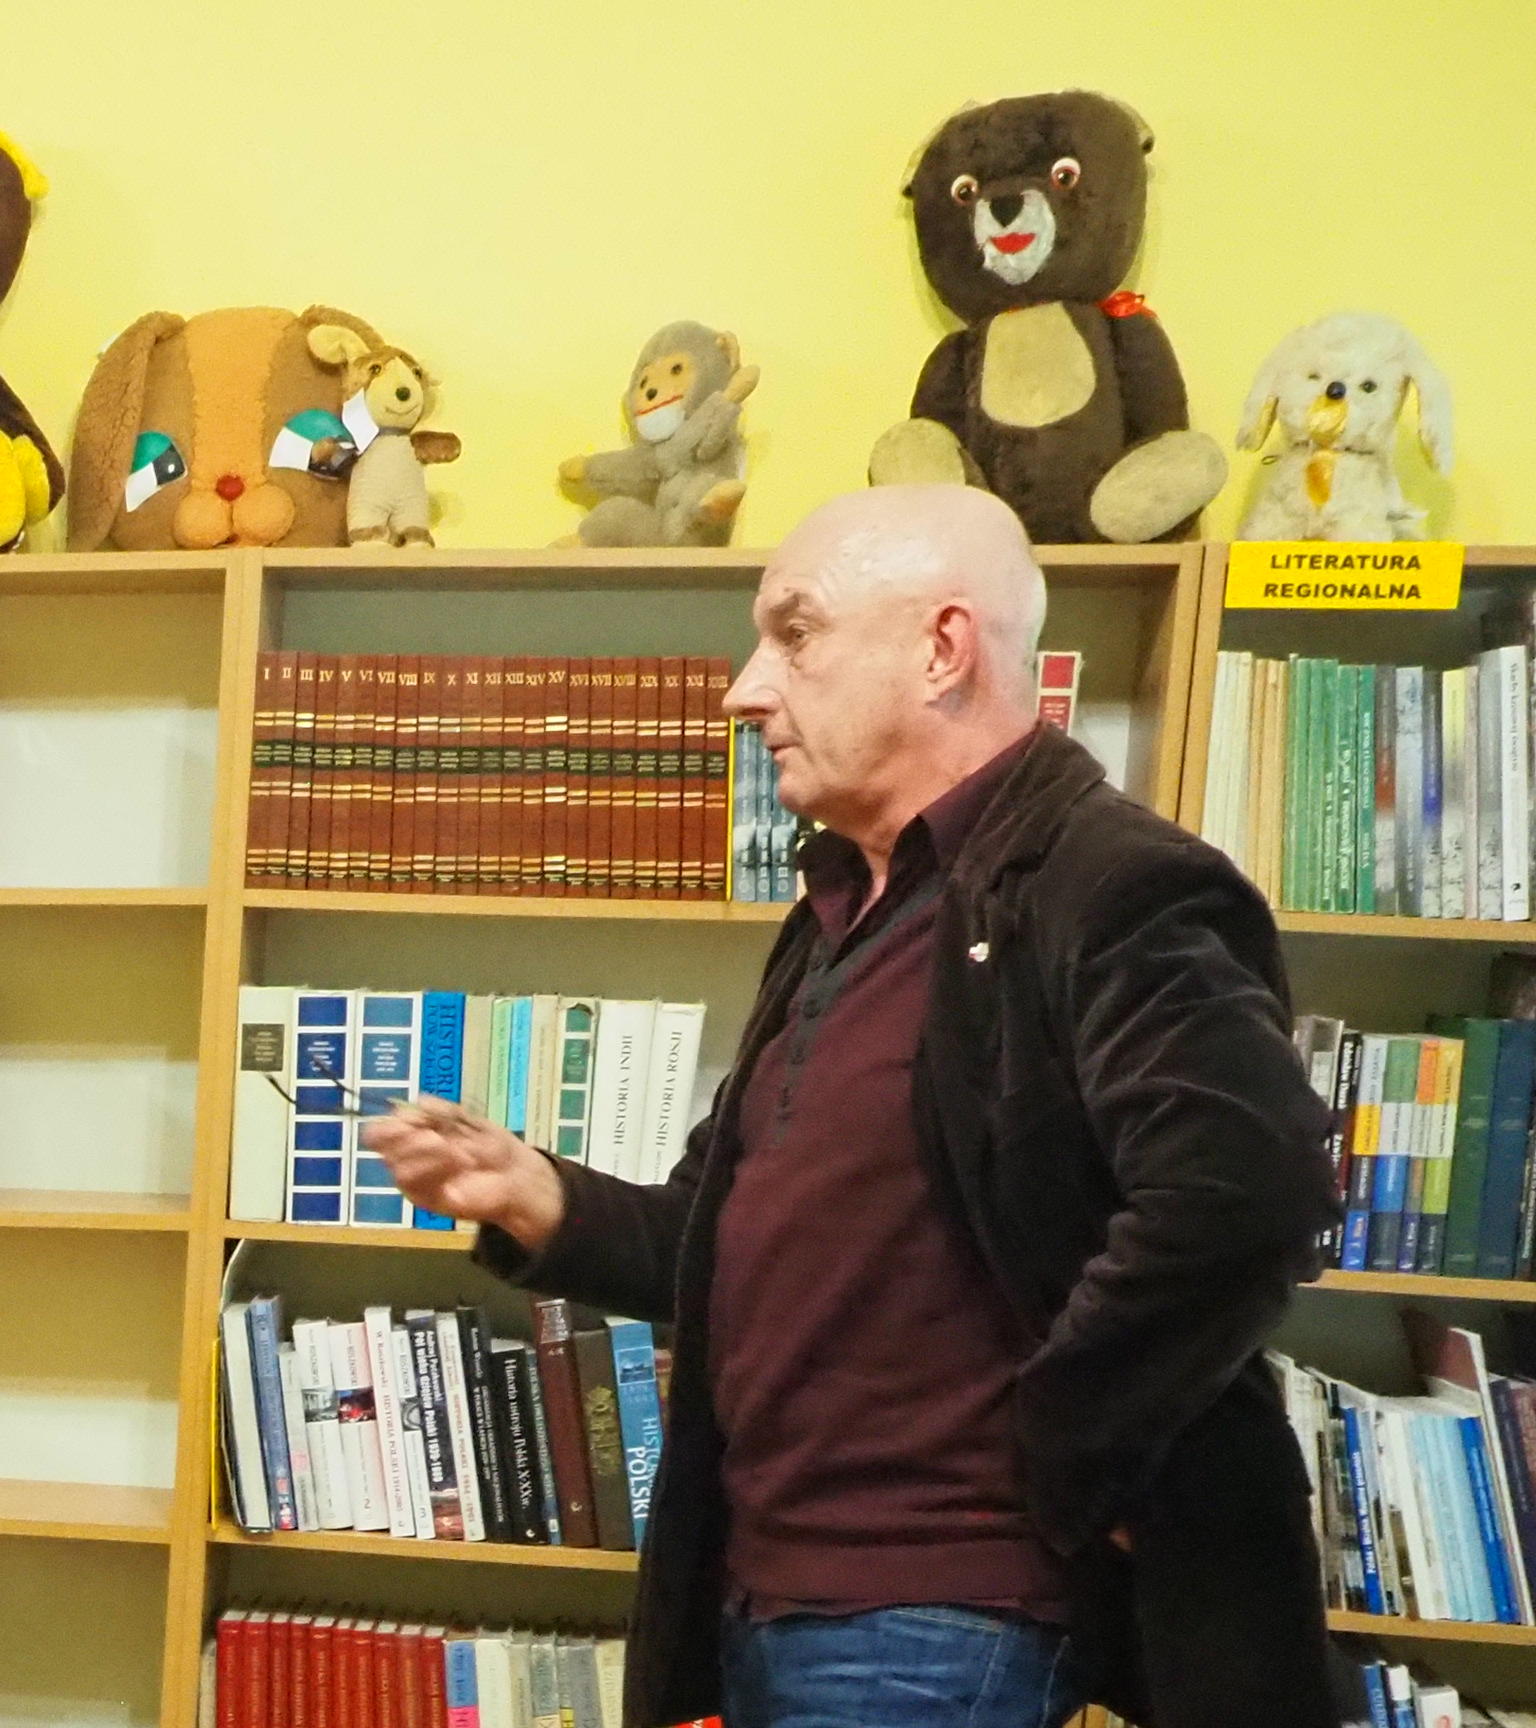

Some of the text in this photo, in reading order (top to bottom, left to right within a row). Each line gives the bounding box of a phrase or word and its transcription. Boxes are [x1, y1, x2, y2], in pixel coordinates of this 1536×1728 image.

[1270, 553, 1422, 571] LITERATURA
[1263, 582, 1422, 600] REGIONALNA
[282, 668, 291, 679] II
[300, 669, 313, 682] III
[319, 670, 333, 682] IV
[342, 670, 352, 681] V
[378, 671, 395, 683] VII
[399, 674, 417, 685] VIII
[423, 672, 435, 684] IX
[466, 673, 478, 684] XI
[484, 673, 501, 685] XII
[505, 673, 524, 685] XIII
[527, 674, 545, 685] XIV
[549, 672, 565, 683] XV
[448, 675, 456, 685] X
[570, 675, 589, 687] XVI
[591, 675, 611, 687] XVII
[640, 676, 658, 688] XIX
[664, 675, 679, 687] XX
[686, 675, 705, 687] XXI
[613, 1034, 634, 1145] HISTORIA INDII
[655, 1030, 683, 1147] HISTORIA ROSJI
[503, 1358, 518, 1400] Historia
[514, 1438, 527, 1468] Polski
[626, 1446, 650, 1520] POLSKI
